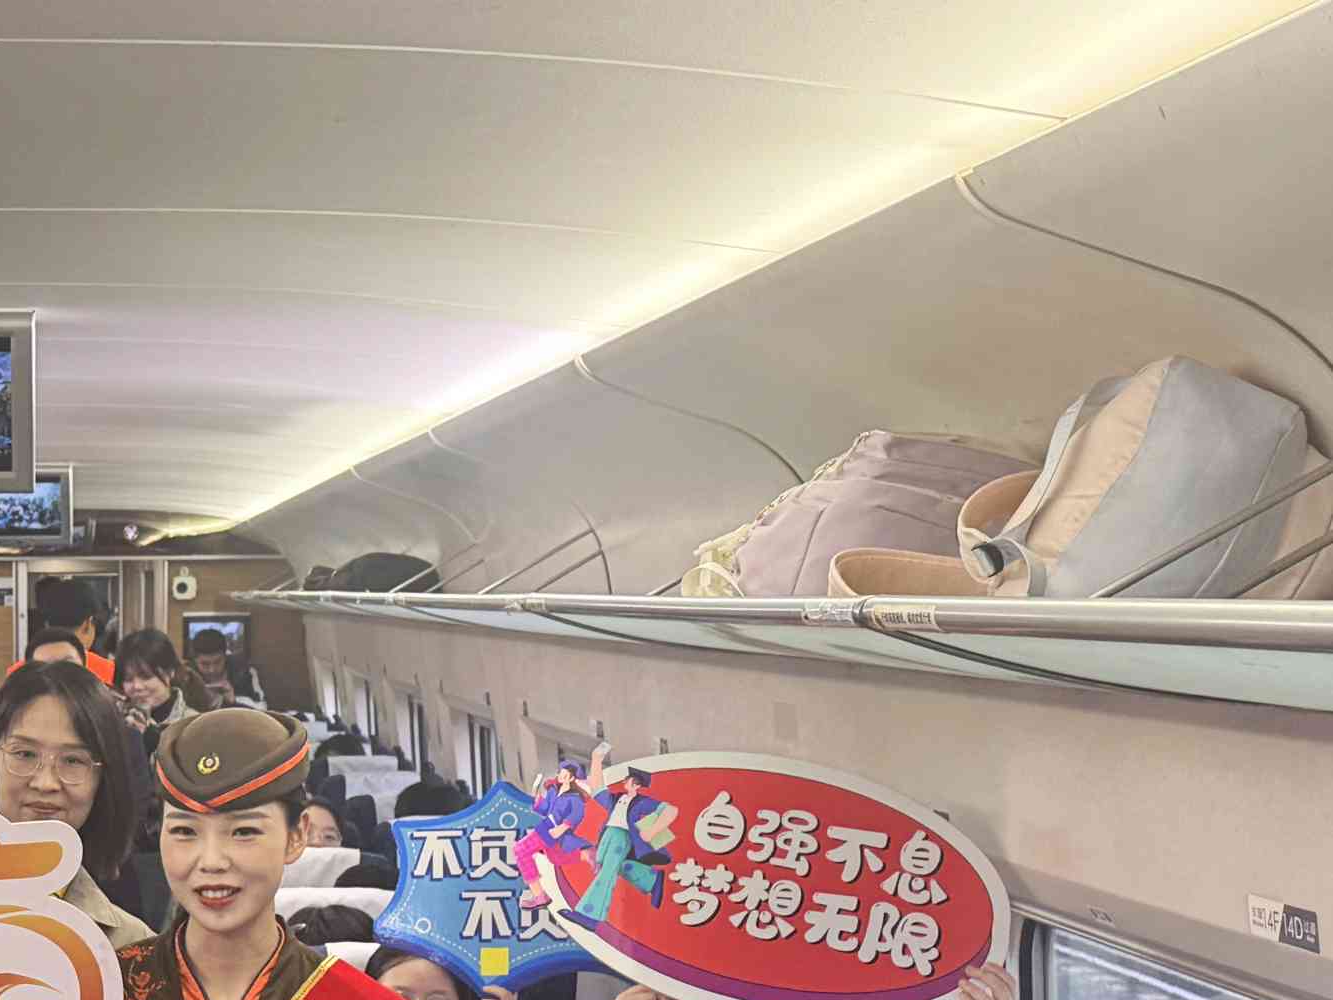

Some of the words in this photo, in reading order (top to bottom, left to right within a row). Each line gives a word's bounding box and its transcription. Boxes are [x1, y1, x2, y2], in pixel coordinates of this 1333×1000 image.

[412, 826, 535, 880] 不负
[693, 790, 947, 904] 自强不息
[669, 859, 939, 976] 梦想无限
[1282, 912, 1304, 941] 14D
